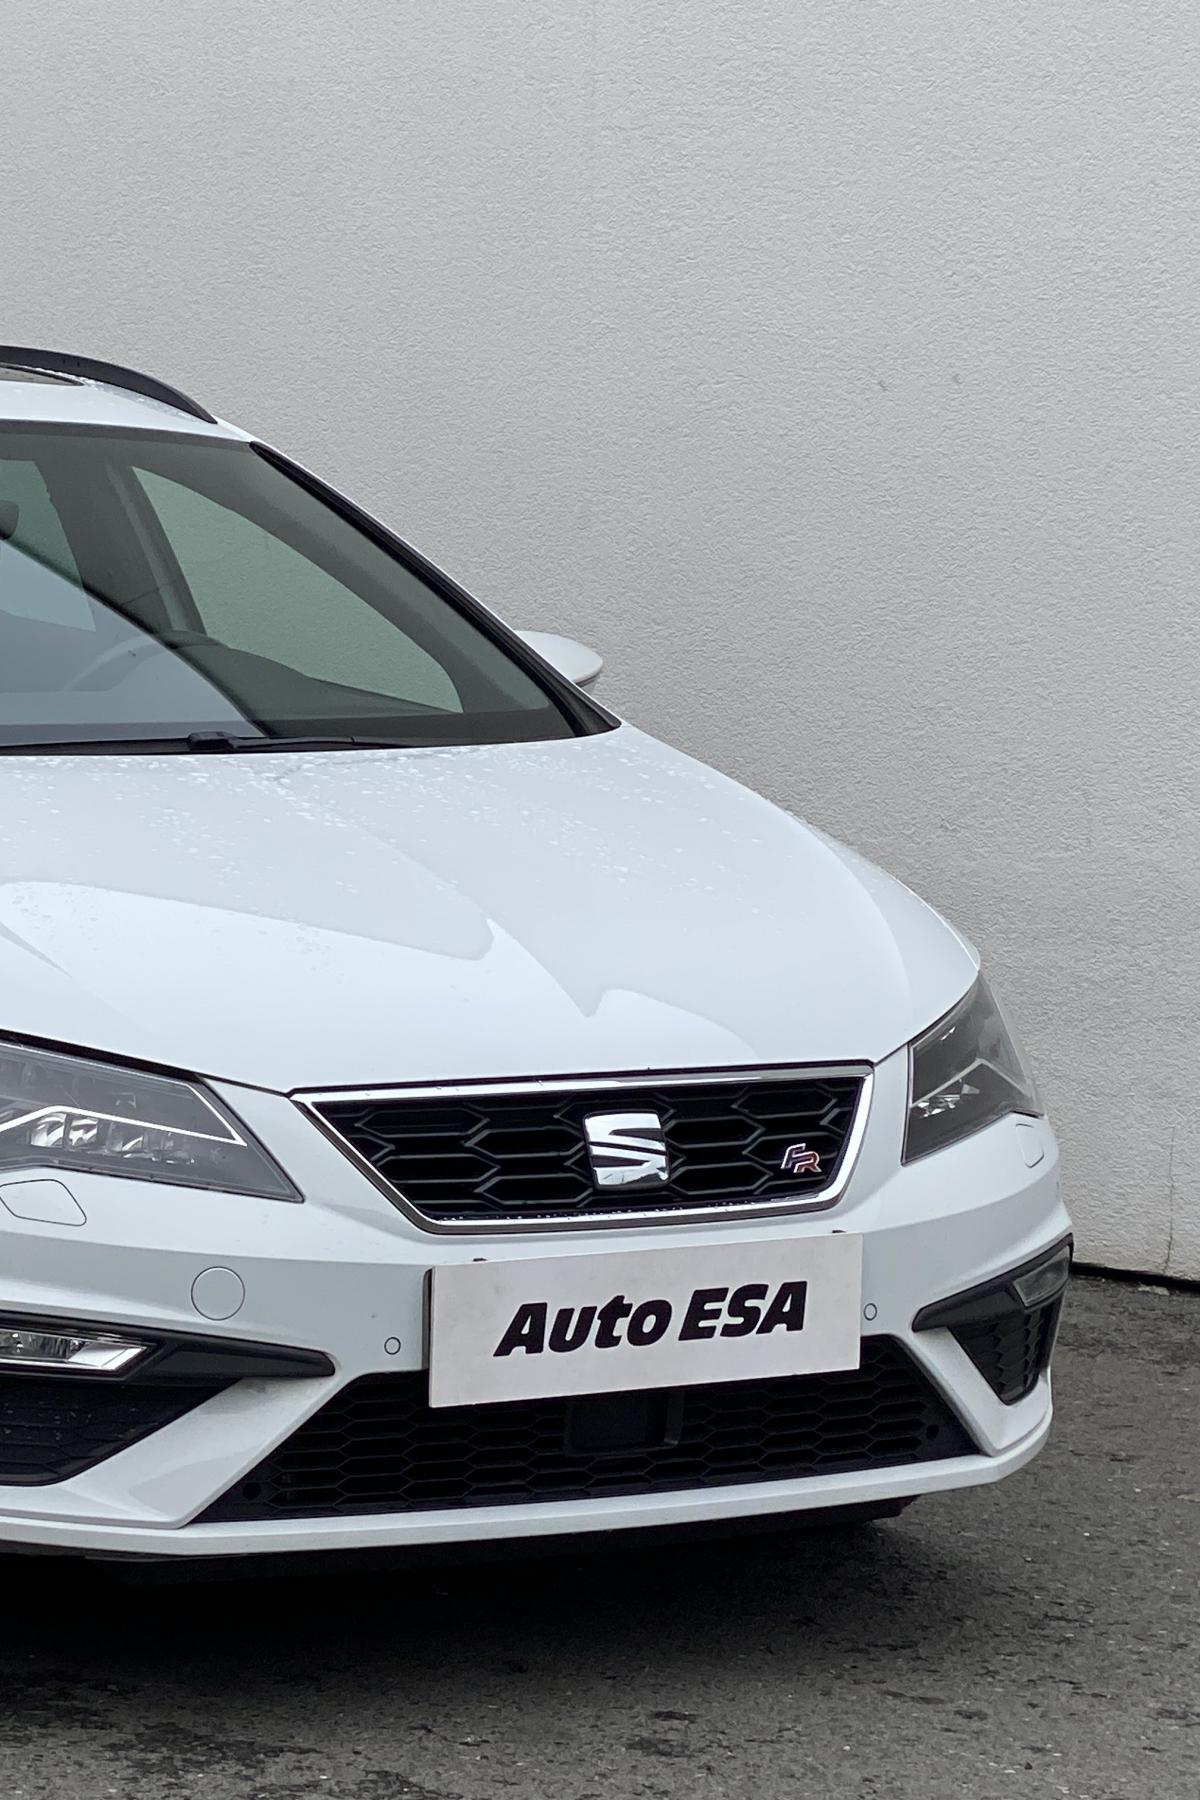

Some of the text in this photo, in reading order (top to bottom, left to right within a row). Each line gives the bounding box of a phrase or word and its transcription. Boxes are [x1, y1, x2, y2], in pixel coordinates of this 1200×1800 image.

[780, 1142, 822, 1174] FR
[492, 1280, 808, 1358] Auto ESA
